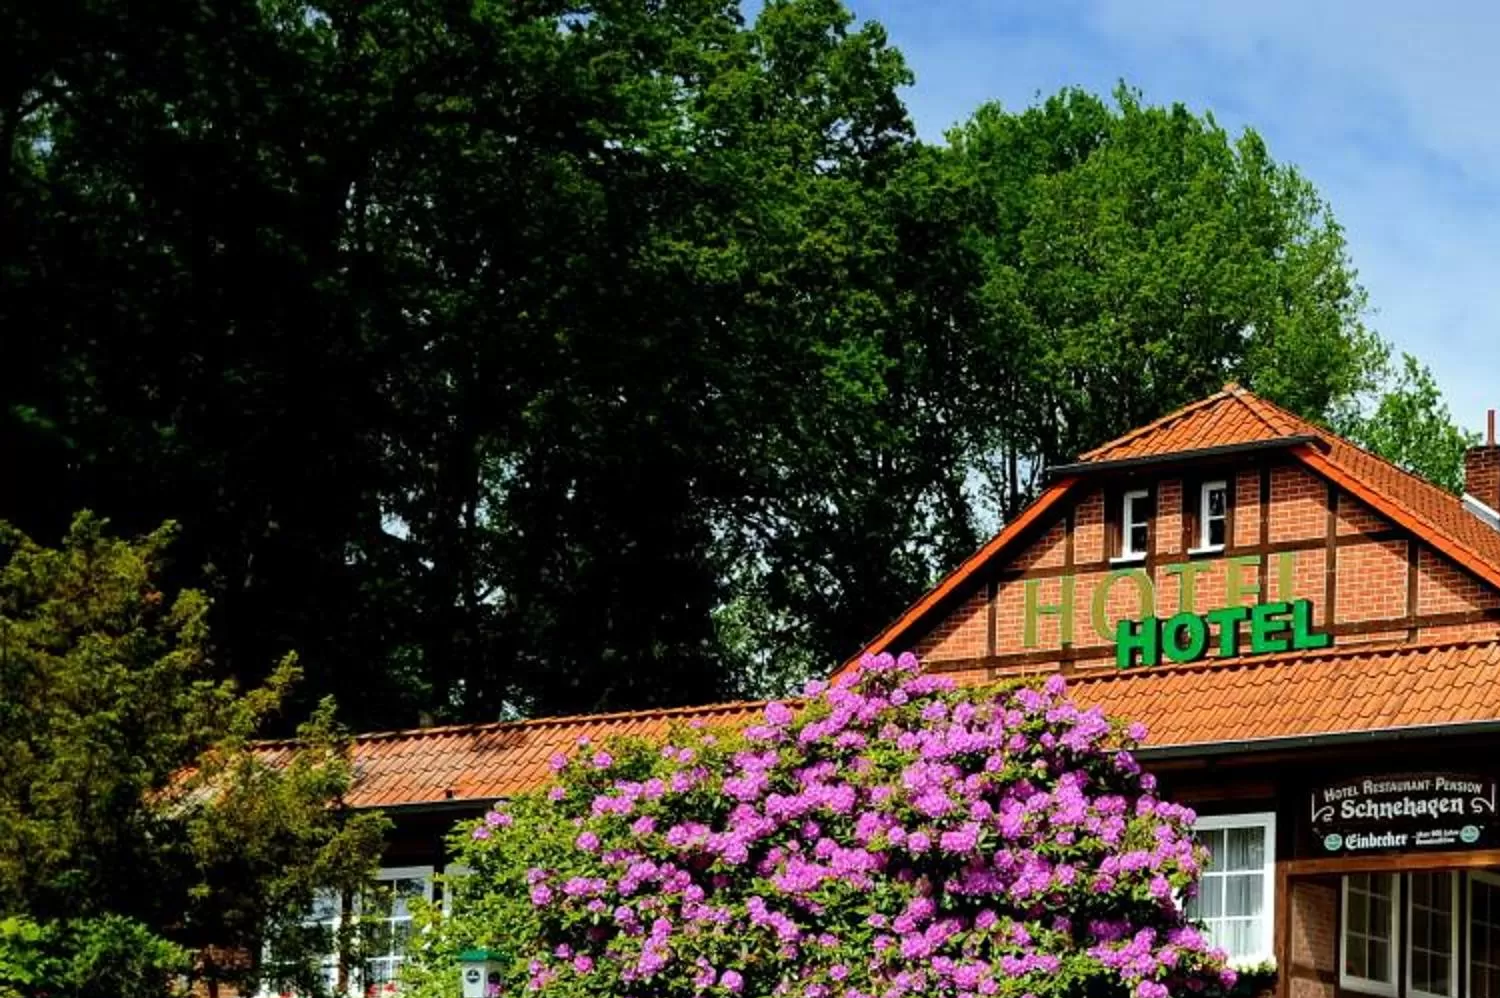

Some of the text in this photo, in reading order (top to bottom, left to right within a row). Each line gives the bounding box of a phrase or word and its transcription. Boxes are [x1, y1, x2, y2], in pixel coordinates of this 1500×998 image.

[1116, 599, 1329, 669] HOTEL
[1324, 785, 1359, 802] HOTEL
[1341, 797, 1464, 819] Schnehagen
